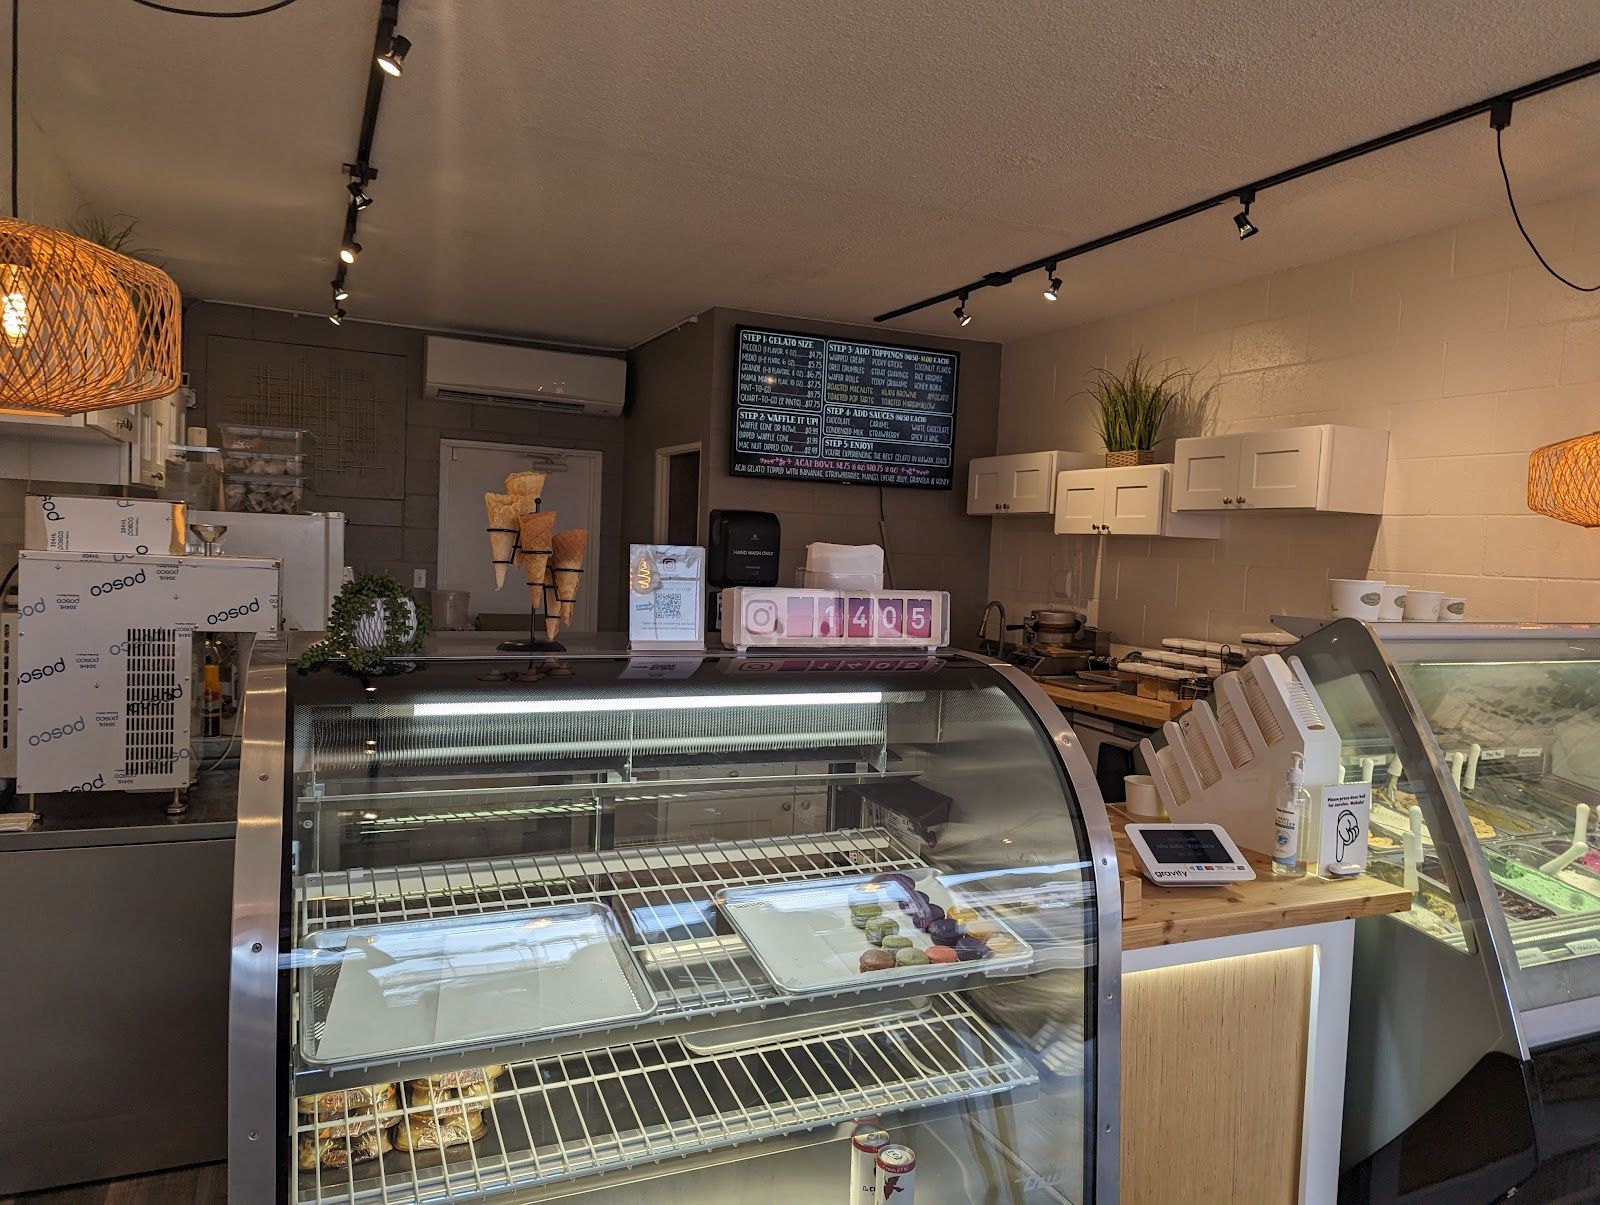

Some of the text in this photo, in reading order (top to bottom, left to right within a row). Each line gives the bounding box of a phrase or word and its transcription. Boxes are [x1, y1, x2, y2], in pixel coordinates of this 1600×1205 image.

[743, 333, 814, 349] STEP GELATO SIZE
[742, 343, 761, 352] PICCOLO
[809, 351, 823, 359] $4.75
[829, 344, 847, 352] STEP
[854, 347, 870, 355] ADD
[872, 350, 903, 360] TOPPINGS
[742, 353, 757, 361] MEDIO
[808, 361, 822, 369] $5.75
[829, 353, 865, 364] WHIPPED CREAM
[872, 358, 903, 369] POCKY STICKS
[742, 363, 761, 372] GRANDE
[828, 363, 840, 371] OREO
[914, 363, 951, 374] COCONUT FLAKES
[741, 373, 756, 382] MAMA
[807, 381, 821, 389] $7.75
[828, 373, 859, 383] WAFER ROLLS
[914, 372, 924, 380] RICE
[827, 383, 848, 392] ROASTED
[871, 378, 885, 386] TEDDY
[914, 382, 928, 390] HONEY
[741, 384, 771, 393] PINT-TO-GO
[740, 393, 777, 404] QUART-TO-GO
[785, 398, 800, 408] PINTS)
[805, 400, 820, 408] $17.75
[827, 393, 848, 402] TOASTED
[860, 396, 874, 404] TARTS
[881, 398, 901, 407] TOASTED
[740, 412, 758, 420] STEP
[767, 414, 796, 423] WAFFLE
[806, 417, 818, 425] UP!
[827, 407, 844, 415] STEP
[852, 409, 868, 418] ADD
[870, 411, 895, 420] SAUCES
[826, 417, 850, 425] CHOCOLATE
[870, 420, 889, 429] CARAMEL
[740, 421, 758, 430] WAFFLE
[760, 422, 772, 431] CONE
[782, 425, 796, 433] BOWL
[826, 426, 852, 435] CONDENSED
[911, 424, 949, 434] WHITE CHOCOLATE
[739, 431, 818, 445] DIPPED WAFFLE CONE $1.99
[869, 430, 900, 439] STRAWBERRY
[738, 441, 749, 449] MAC
[751, 442, 762, 450] NUT
[764, 443, 780, 451] DIPPED
[825, 440, 873, 450] STEP ENJOY!
[795, 459, 812, 467] ACAI
[814, 460, 835, 468] BOWL
[766, 466, 784, 474] TOPPED
[910, 476, 929, 484] GRANOLA
[90, 568, 146, 597] posco
[207, 597, 260, 625] posco
[29, 716, 85, 746] posco
